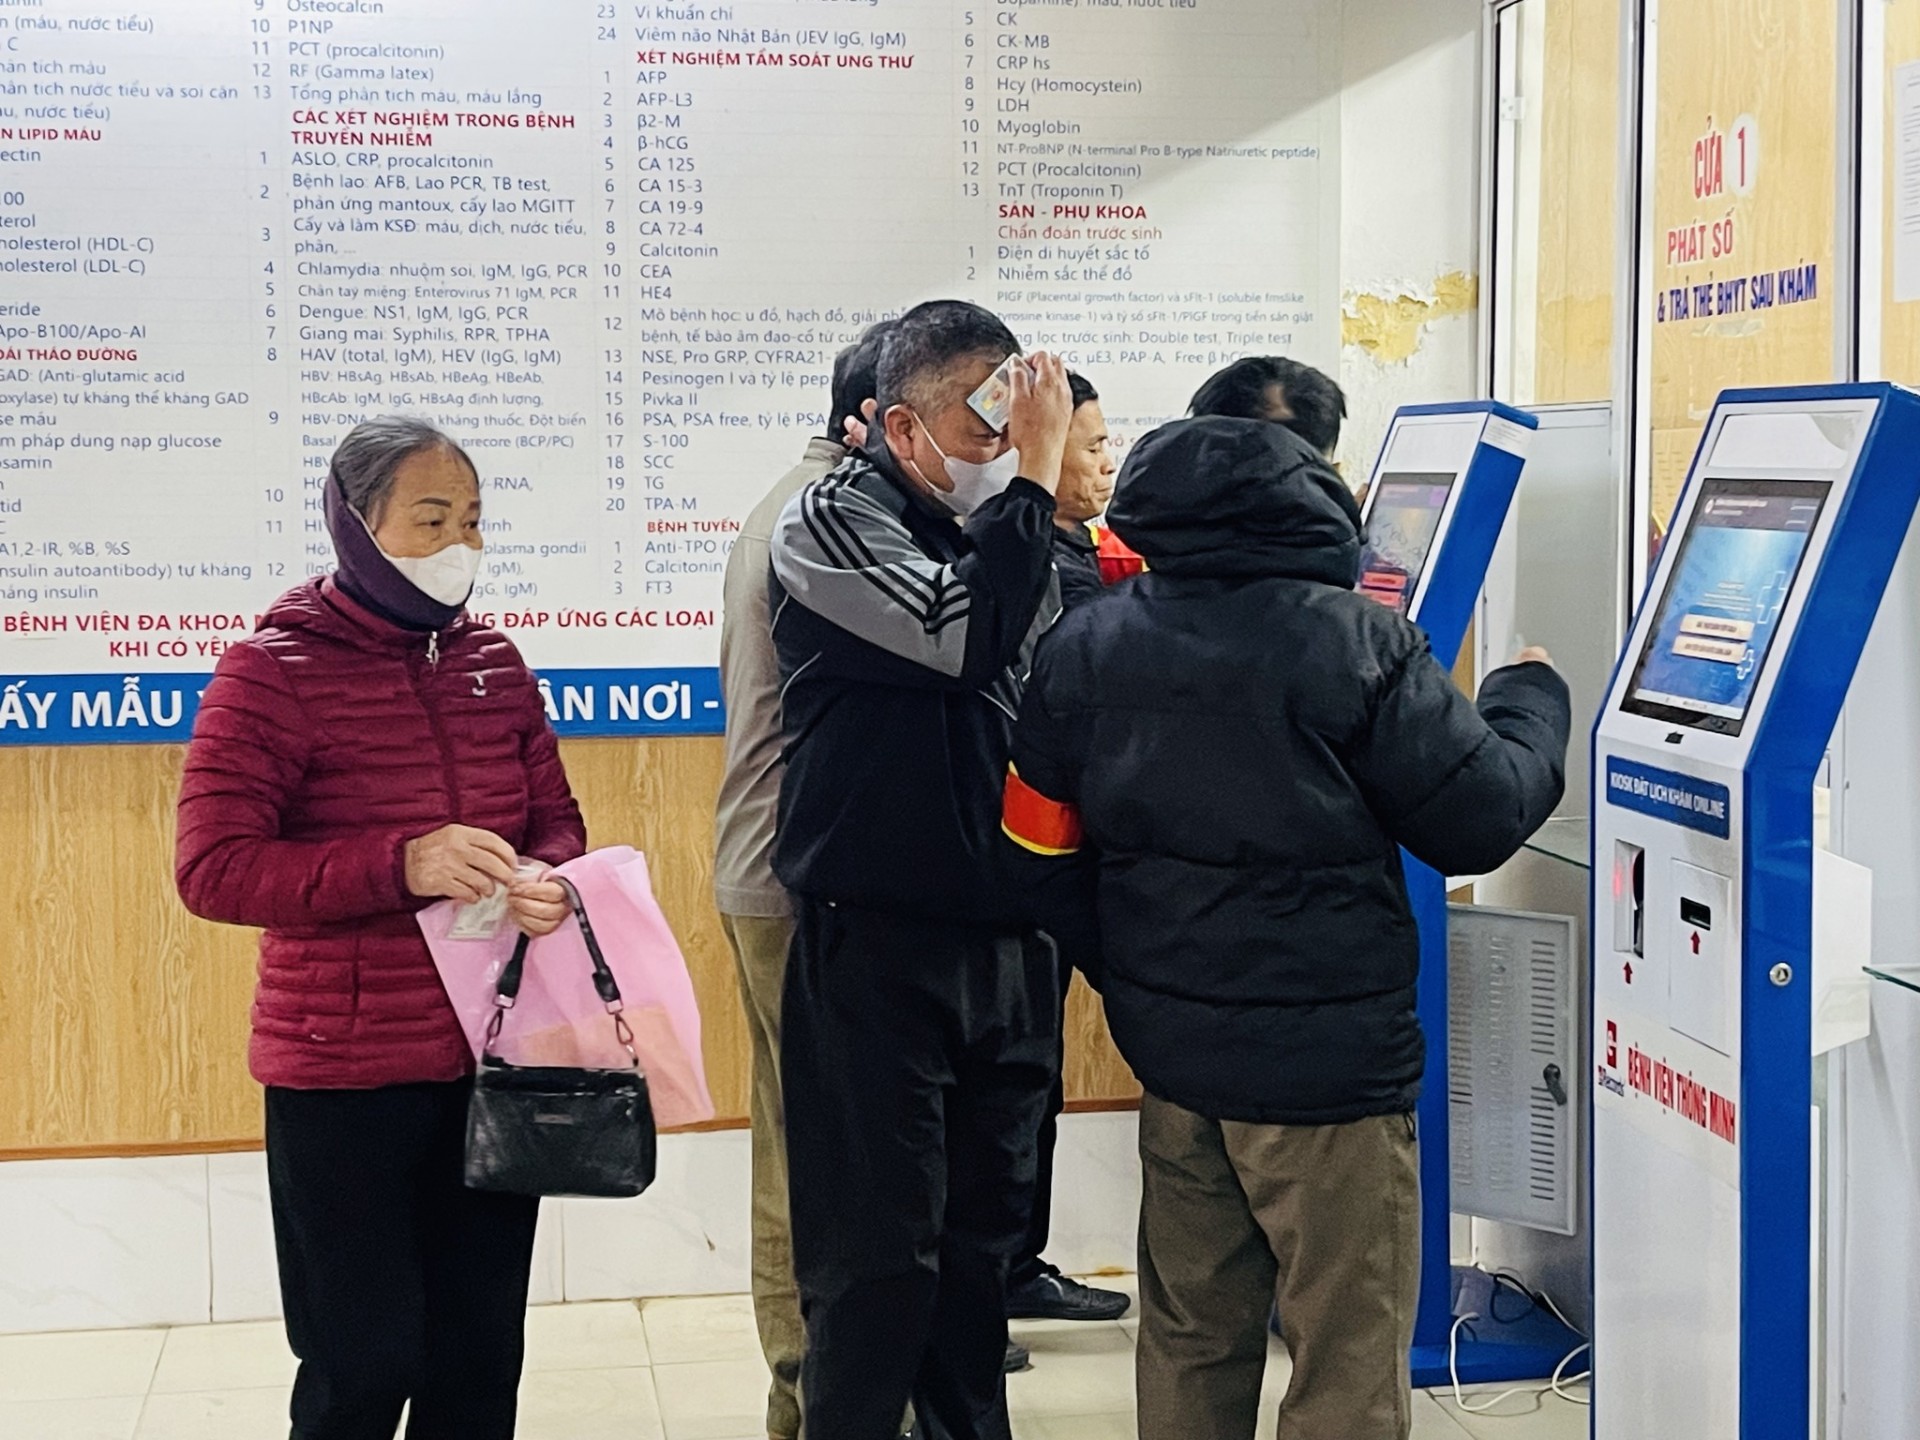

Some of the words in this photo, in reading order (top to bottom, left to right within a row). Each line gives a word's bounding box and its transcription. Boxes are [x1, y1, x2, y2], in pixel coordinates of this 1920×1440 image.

[965, 11, 973, 25] 5
[997, 12, 1017, 26] CK
[251, 19, 270, 33] 10
[289, 19, 333, 34] P1NP
[965, 34, 974, 47] 6
[997, 34, 1049, 48] CK-MB
[252, 41, 268, 55] 11
[289, 42, 320, 56] PCT
[327, 43, 444, 60] (procalcitonin)
[637, 51, 666, 64] XÉT
[673, 51, 740, 68] NGHIỆM
[789, 52, 831, 67] SOÁT
[837, 55, 873, 68] UNG
[878, 55, 914, 68] THƯ
[966, 55, 973, 68] 7
[997, 55, 1028, 69] CRP
[1034, 56, 1050, 70] hs
[605, 71, 609, 83] 1
[637, 71, 667, 84] AFP
[965, 77, 974, 90] 8
[998, 77, 1026, 95] Hcy
[1032, 78, 1141, 96] (Homocystein)
[603, 92, 611, 106] 2
[637, 92, 692, 107] AFP-L3
[965, 98, 974, 111] 9
[998, 98, 1029, 112] LDH
[293, 108, 328, 124] CÁC
[336, 109, 367, 124] XÉT
[374, 110, 448, 126] NGHIỆM
[455, 114, 519, 127] TRONG
[526, 109, 574, 130] BỆNH
[605, 114, 612, 127] 3
[638, 114, 680, 129] β2-M
[19, 128, 58, 140] LIPID
[64, 129, 101, 141] MÁU
[962, 119, 979, 133] 10
[998, 119, 1080, 137] Myoglobin
[604, 136, 612, 148] 4
[638, 135, 688, 152] β-hCG
[261, 152, 266, 164] 1
[292, 152, 339, 166] ASLO,
[346, 153, 380, 167] CRP,
[388, 154, 493, 170] procalcitonin
[605, 157, 613, 170] 5
[638, 157, 661, 171] CA
[1694, 116, 1722, 199] CỬA
[1738, 127, 1745, 187] 1
[963, 162, 979, 175] 12
[998, 162, 1027, 176] PCT
[1033, 162, 1141, 179] (Procalcitonin)
[605, 178, 614, 192] 6
[639, 178, 661, 192] CA
[669, 179, 702, 193] 15-3
[963, 183, 979, 196] 13
[999, 183, 1025, 198] TnT
[1031, 184, 1104, 200] (Troponin
[1110, 184, 1123, 200] T)
[606, 199, 614, 212] 7
[639, 200, 661, 214] CA
[669, 201, 703, 214] 19-9
[1054, 205, 1089, 221] PHỤ
[1097, 205, 1146, 219] KHOA
[606, 221, 615, 234] 8
[640, 221, 662, 235] CA
[669, 222, 702, 235] 72-4
[1042, 225, 1080, 239] đoán
[1087, 228, 1126, 240] trước
[1132, 227, 1162, 240] sinh
[1667, 219, 1706, 265] PHÁT
[1712, 207, 1735, 258] SỐ
[88, 237, 153, 254] (HDL-C)
[606, 242, 615, 255] 9
[640, 243, 718, 257] Calcitonin
[84, 259, 145, 275] (LDL-C)
[604, 264, 621, 277] 10
[640, 264, 671, 278] CEA
[604, 285, 619, 298] 11
[641, 286, 671, 299] HE4
[1657, 292, 1665, 323] &
[1669, 276, 1689, 321] TRẢ
[1693, 271, 1713, 318] THẺ
[1717, 278, 1747, 316] BHYT
[1751, 272, 1774, 310] SAU
[1778, 258, 1817, 305] KHÁM
[266, 304, 275, 317] 6
[300, 304, 367, 322] Dengue:
[374, 305, 409, 320] NS1,
[417, 306, 452, 323] IgM,
[459, 306, 489, 324] IgG,
[497, 306, 528, 320] PCR
[27, 347, 71, 360] THÁO
[77, 347, 137, 361] ĐƯỜNG
[267, 347, 277, 361] 8
[301, 348, 336, 361] HAV
[343, 349, 387, 364] (total,
[395, 349, 435, 366] IgM),
[442, 349, 475, 362] HEV
[481, 349, 517, 367] (IgG,
[525, 350, 561, 367] IgM)
[607, 435, 623, 448] 17
[643, 434, 688, 447] S-100
[607, 455, 624, 469] 18
[644, 455, 674, 468] SCC
[607, 477, 624, 490] 19
[644, 476, 664, 489] TG
[606, 498, 625, 511] 20
[644, 497, 696, 510] TPA-M
[648, 519, 687, 534] BỆNH
[692, 519, 739, 532] TUYẾN
[615, 541, 620, 553] 1
[645, 540, 716, 553] Anti-TPO
[614, 561, 622, 574] 2
[645, 560, 722, 573] Calcitonin
[45, 585, 98, 598] insulin
[615, 581, 622, 594] 3
[646, 581, 672, 594] FT3
[4, 611, 67, 635] BỆNH
[76, 610, 129, 635] VIỆN
[138, 615, 171, 630] ĐA
[179, 615, 246, 630] KHOA
[504, 608, 549, 627] ĐÁP
[557, 608, 607, 627] ỨNG
[615, 606, 658, 627] CÁC
[666, 610, 714, 630] LOẠI
[110, 641, 148, 657] KHI
[157, 637, 187, 657] CÓ
[72, 676, 182, 728] MẪU
[609, 680, 691, 721] NƠI
[1610, 771, 1632, 793] KIOSK
[1650, 783, 1668, 804] LỊCH
[1669, 787, 1692, 810] KHÁM
[1694, 796, 1725, 820] ONLINE
[1628, 1041, 1651, 1099] BỆNH
[1653, 1056, 1674, 1115] VIỆN
[1676, 1070, 1707, 1128] THÔNG
[1710, 1091, 1736, 1145] MINH
